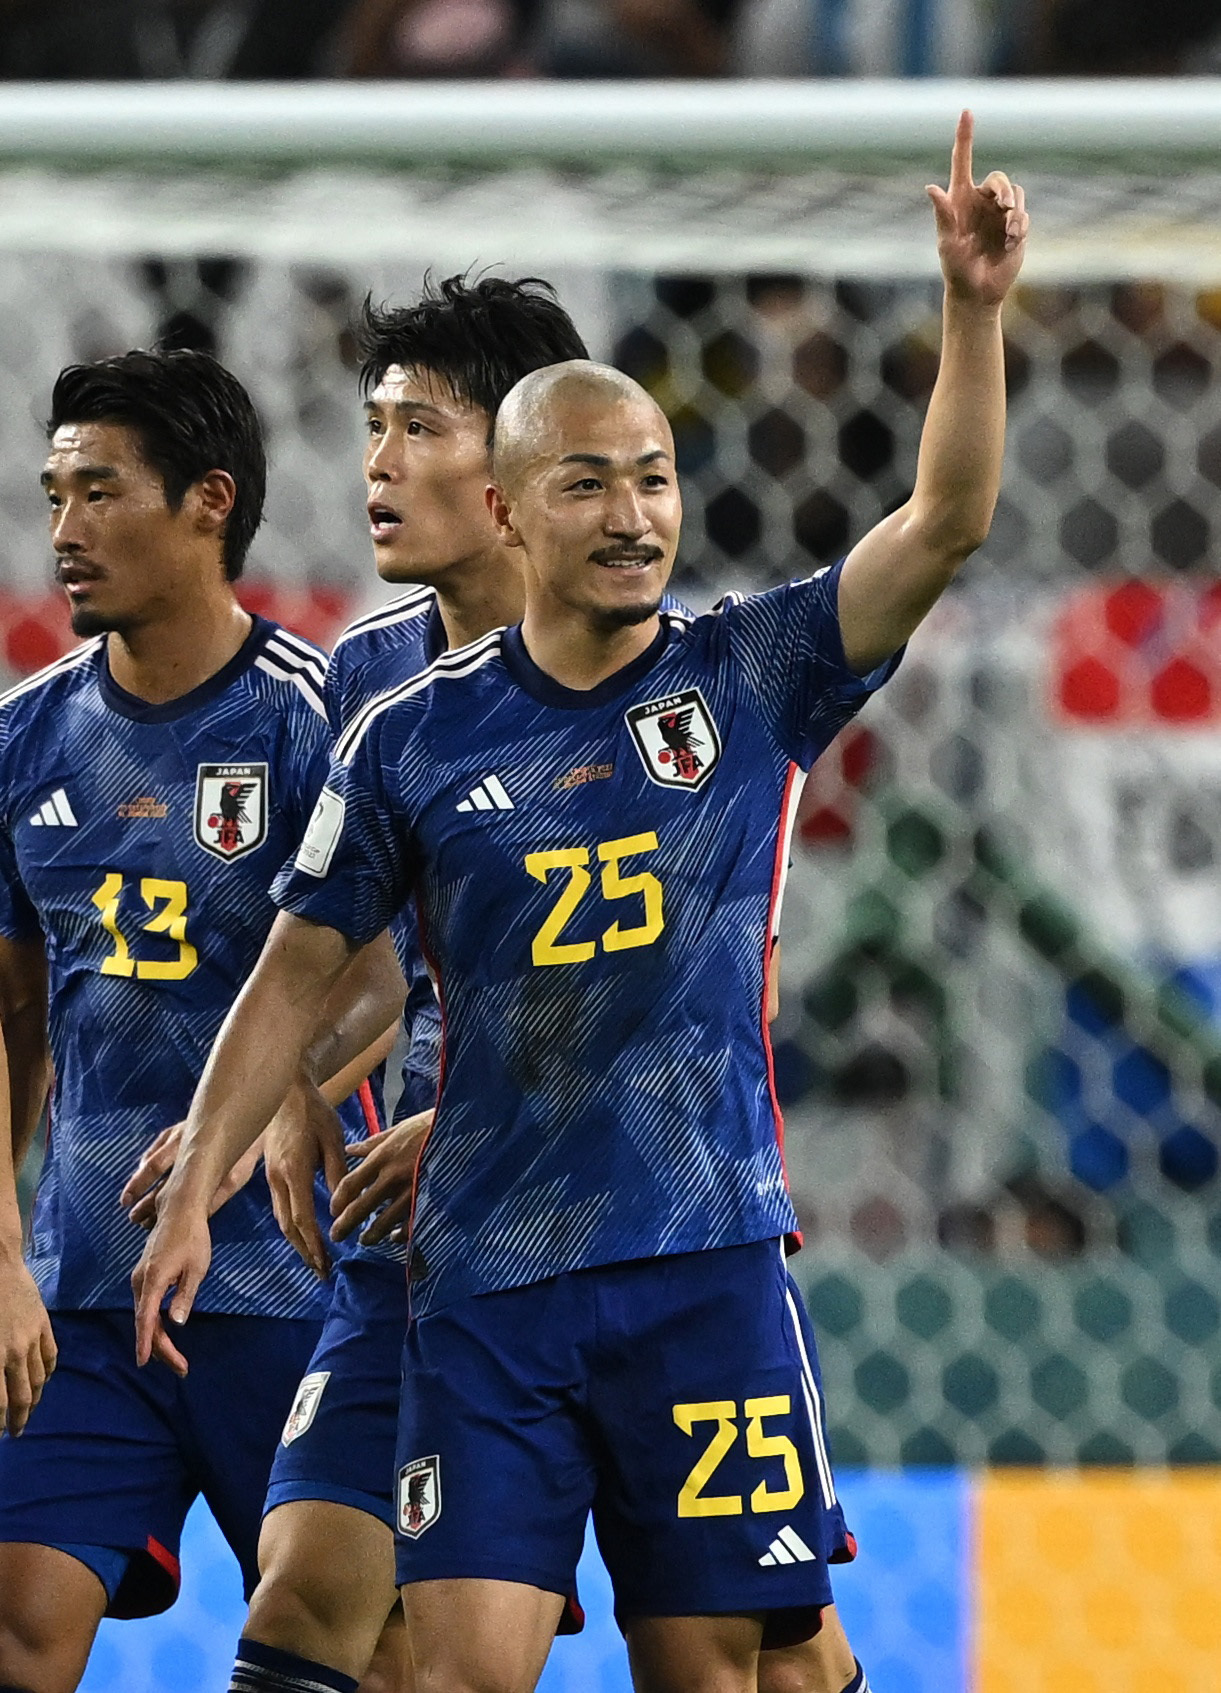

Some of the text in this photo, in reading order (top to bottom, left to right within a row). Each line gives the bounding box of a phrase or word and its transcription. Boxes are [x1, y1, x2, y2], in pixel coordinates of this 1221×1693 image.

[644, 697, 682, 715] JAPAN
[216, 767, 251, 776] JAPAN
[672, 754, 705, 778] JFA
[213, 829, 244, 844] JFA
[524, 831, 665, 966] 25
[91, 873, 198, 980] 13
[672, 1395, 804, 1518] 25
[405, 1461, 427, 1475] JAPAN
